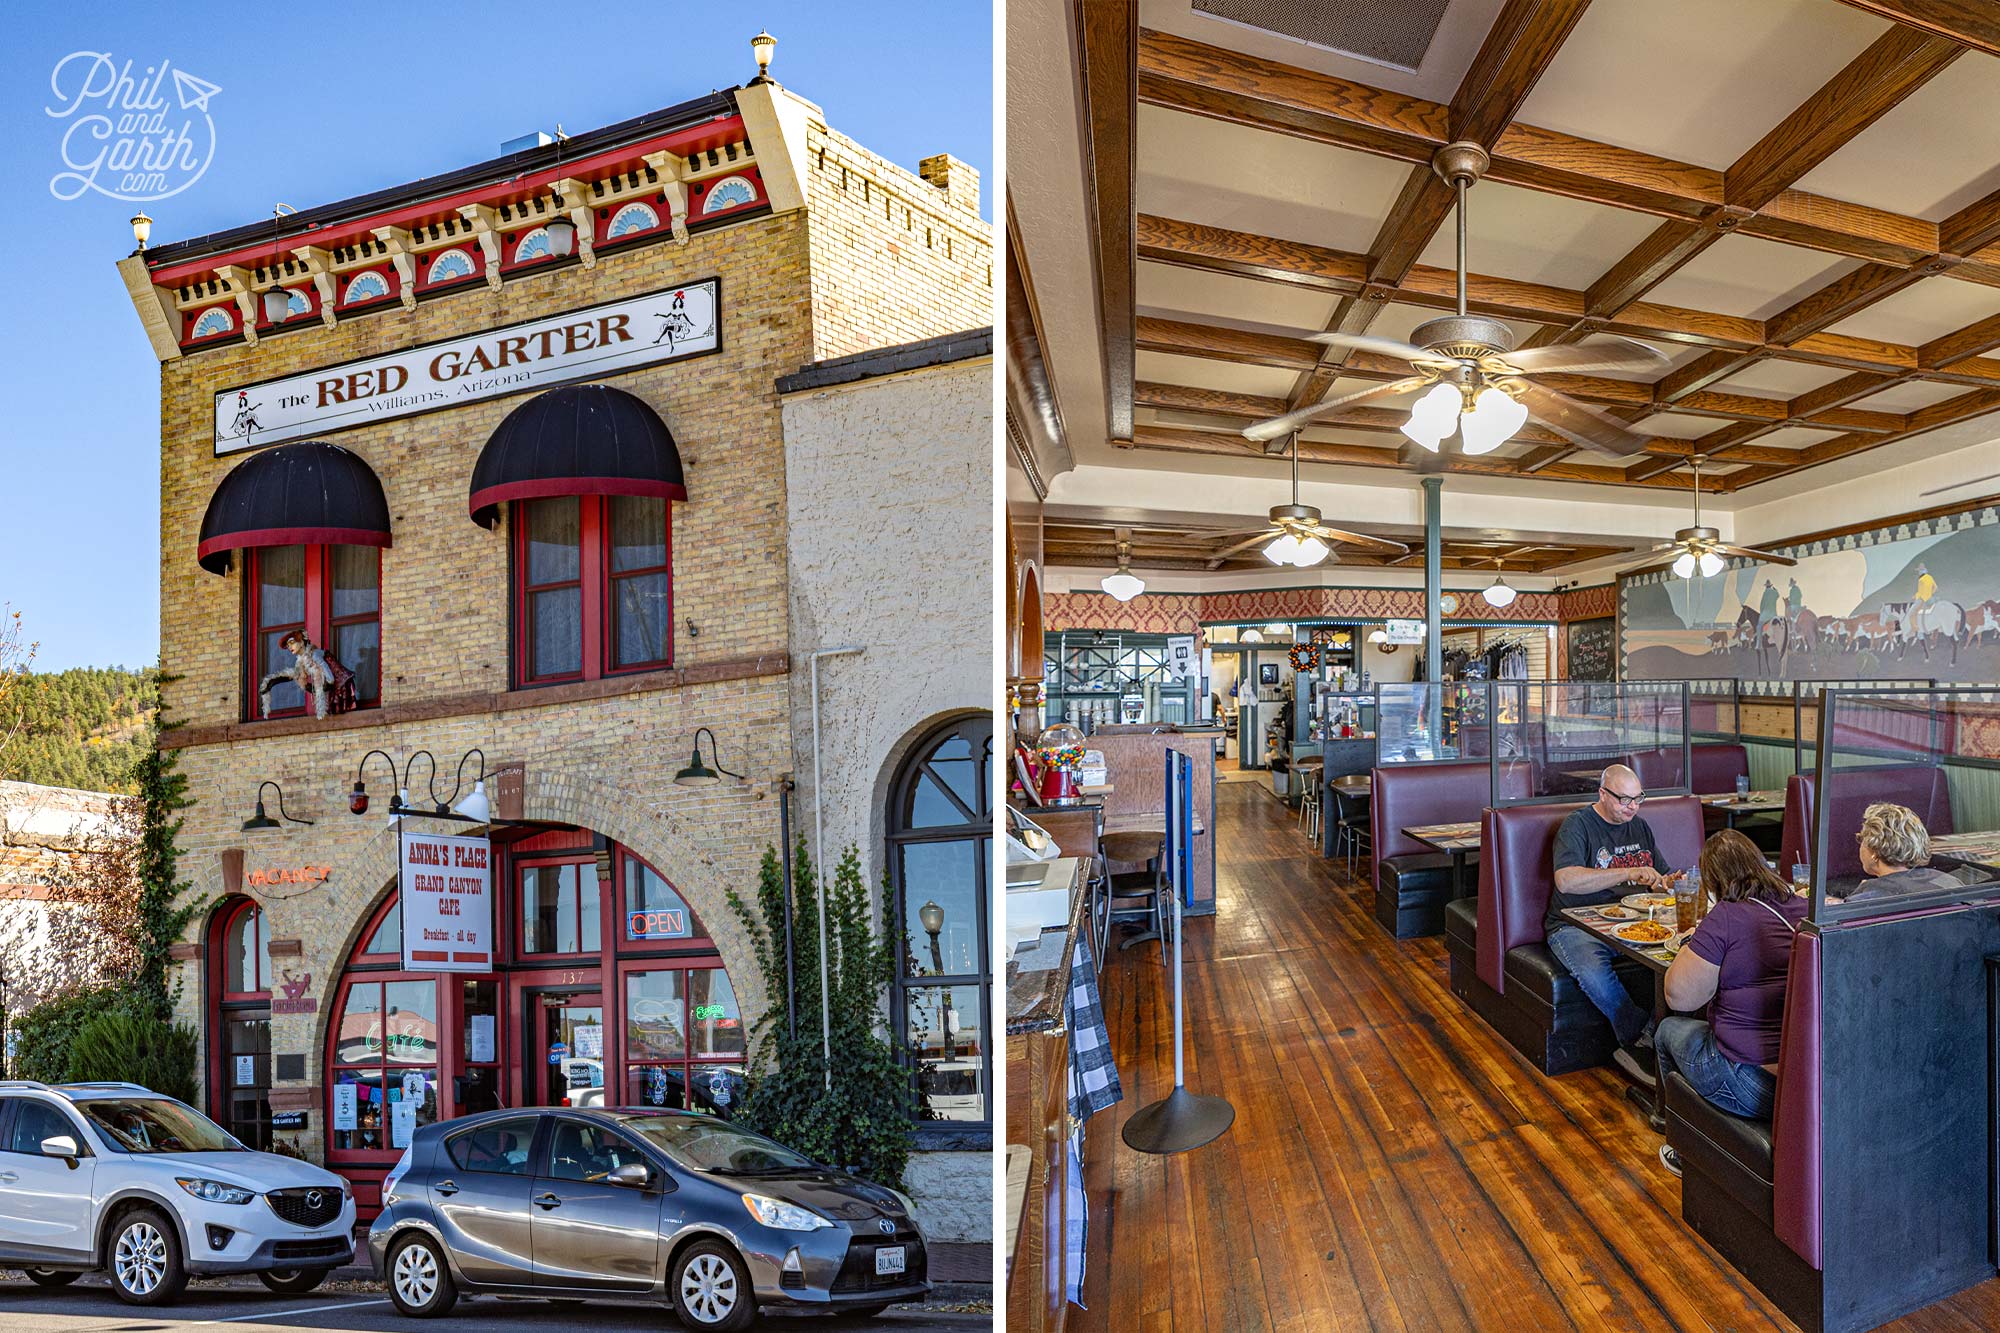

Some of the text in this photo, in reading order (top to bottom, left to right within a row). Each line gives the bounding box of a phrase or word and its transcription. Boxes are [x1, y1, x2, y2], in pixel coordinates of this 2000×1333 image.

[278, 314, 634, 410] The RED GARTER
[367, 370, 531, 414] Williams, Arizona
[408, 842, 487, 869] ANNA'S PLACE
[245, 866, 331, 887] VACANCY
[415, 874, 482, 895] GRAND CANYON
[439, 898, 460, 916] CAFE
[632, 911, 682, 934] OPEN
[424, 928, 450, 942] Breakfast
[467, 930, 476, 944] day
[562, 971, 584, 985] 137
[366, 1022, 425, 1052] Café
